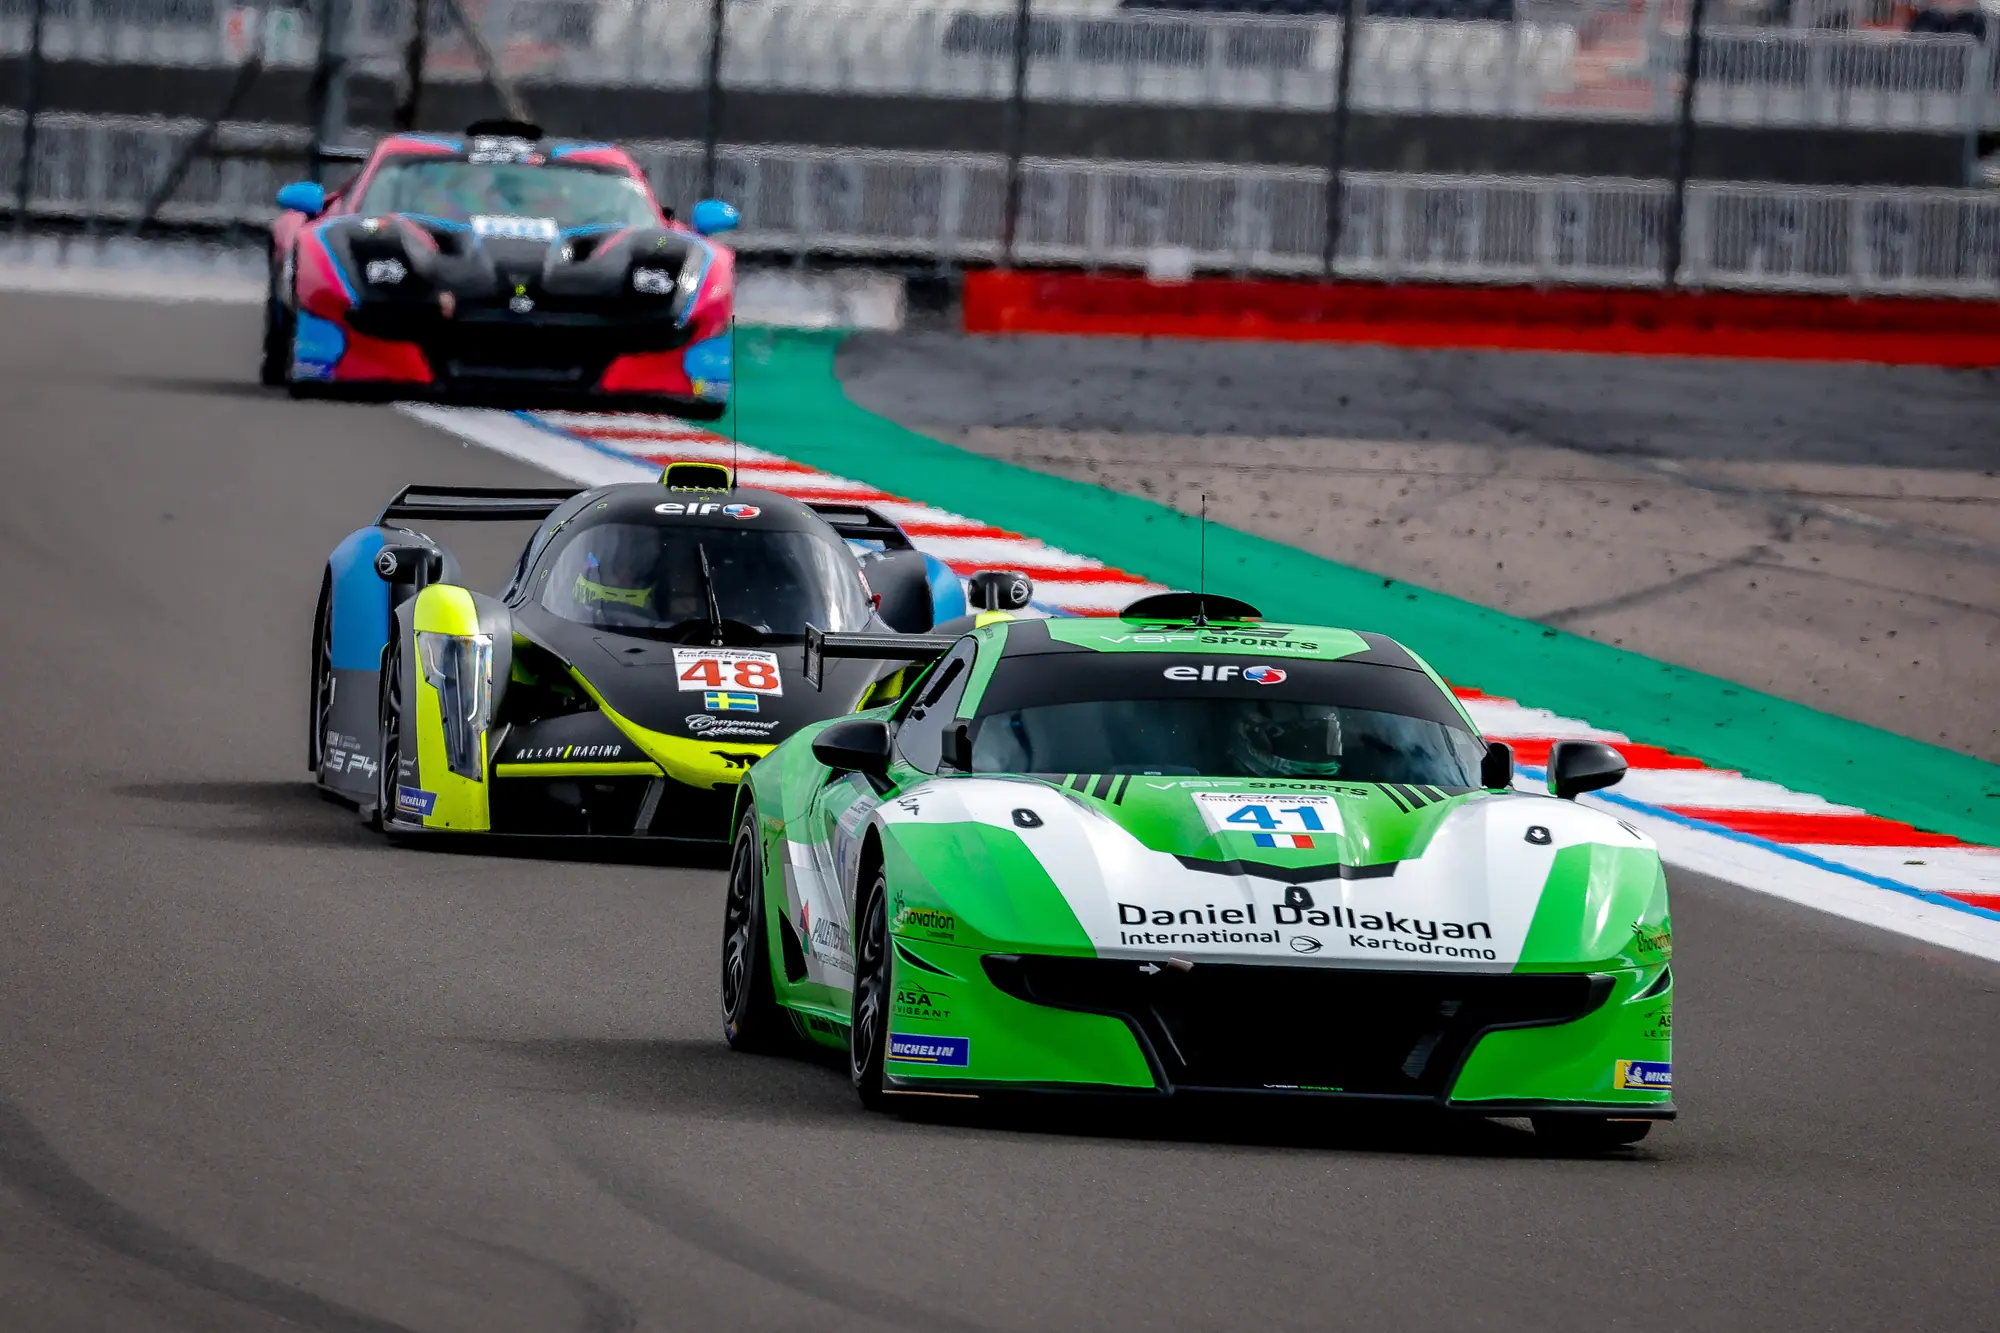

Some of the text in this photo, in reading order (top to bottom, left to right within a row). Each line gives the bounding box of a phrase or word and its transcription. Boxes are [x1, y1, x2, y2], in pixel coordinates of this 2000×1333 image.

[654, 502, 720, 516] elf
[1201, 635, 1319, 650] SPORTS
[680, 659, 779, 690] 48
[1163, 665, 1240, 682] elf
[1248, 782, 1369, 796] SPORTS
[1226, 804, 1325, 831] 41
[1117, 902, 1493, 941] Daniel Dallakyan
[1120, 930, 1497, 961] International Kartodromo
[897, 991, 932, 1007] ASA
[891, 1042, 955, 1057] MICHELIN
